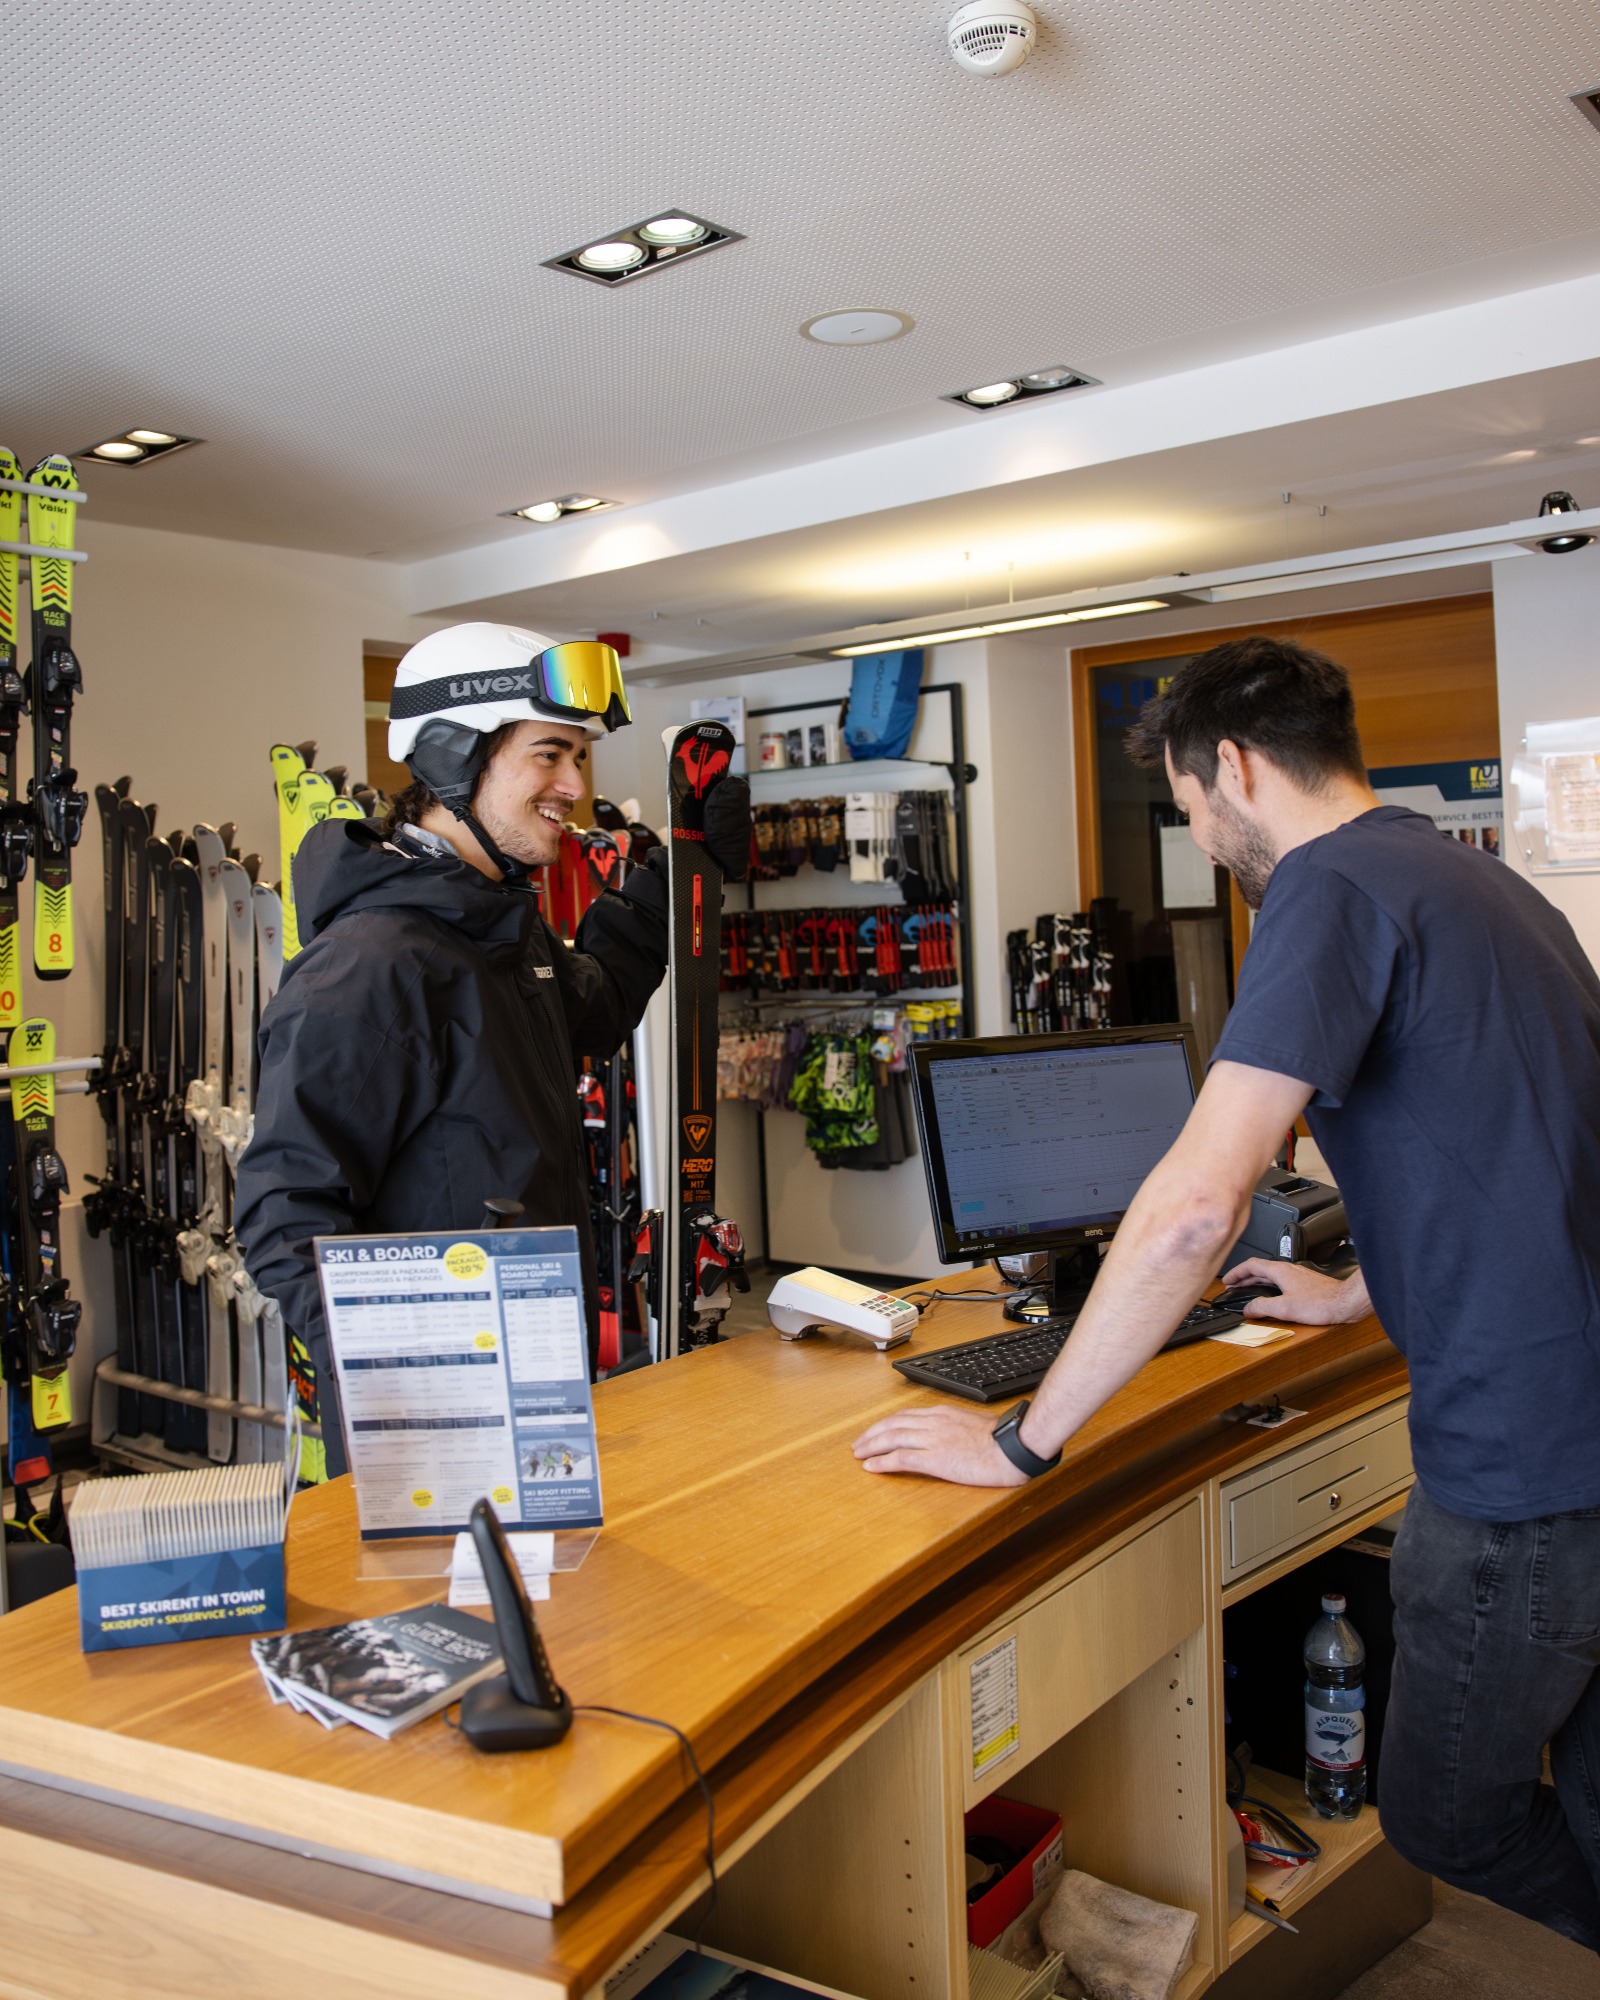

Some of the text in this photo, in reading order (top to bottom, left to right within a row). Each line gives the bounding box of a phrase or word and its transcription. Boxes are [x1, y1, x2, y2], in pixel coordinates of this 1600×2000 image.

[39, 502, 67, 514] Völkl
[43, 610, 66, 620] RACE
[44, 618, 66, 627] TIGER
[450, 673, 534, 699] uvex
[1472, 811, 1491, 820] BEST
[49, 933, 62, 953] 8
[0, 990, 15, 1011] 0
[26, 1117, 46, 1125] RACE
[26, 1124, 47, 1132] TIGER
[681, 1158, 714, 1173] HERO
[690, 1180, 705, 1189] M17
[1084, 1229, 1104, 1237] BenQ
[325, 1249, 354, 1264] SKI
[357, 1247, 372, 1262] &
[374, 1245, 438, 1262] BOARD
[446, 1255, 485, 1266] PACKAGES
[329, 1269, 392, 1278] GRUPPENKURSE
[399, 1267, 440, 1275] PACKAGES
[499, 1263, 540, 1272] PERSONAL
[541, 1262, 553, 1270] SKI
[330, 1278, 357, 1286] GROUP
[359, 1276, 394, 1285] COURSES
[402, 1274, 443, 1283] PACKAGES
[500, 1271, 528, 1279] BOARD
[47, 1393, 59, 1410] 7
[537, 1488, 559, 1496] BOOT
[560, 1487, 591, 1495] FITTING
[100, 1588, 266, 1618] BEST SKIRENT IN TOWN
[101, 1617, 155, 1632] SKIDEPOT
[164, 1609, 226, 1625] SKISERVICE
[236, 1604, 267, 1616] SHOP
[399, 1622, 451, 1648] GUIDE
[443, 1640, 493, 1662] BOOK
[1316, 1715, 1357, 1731] ALPQUELL
